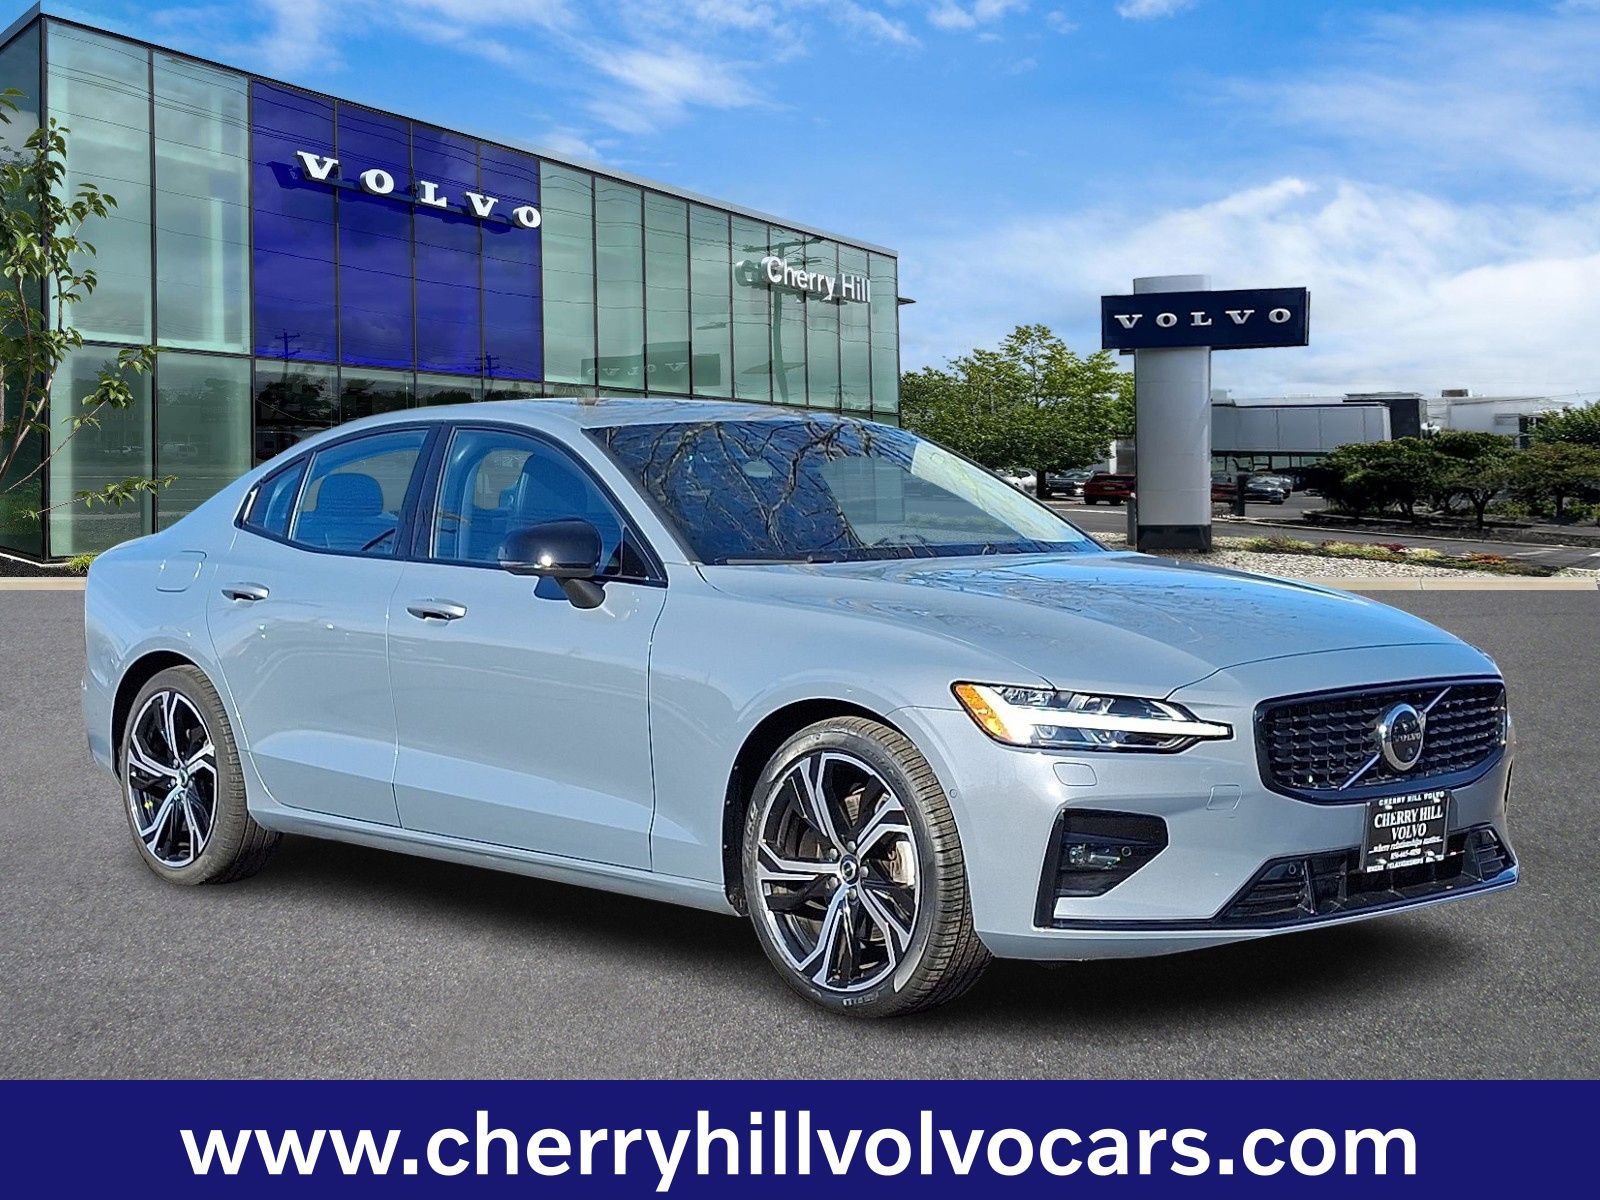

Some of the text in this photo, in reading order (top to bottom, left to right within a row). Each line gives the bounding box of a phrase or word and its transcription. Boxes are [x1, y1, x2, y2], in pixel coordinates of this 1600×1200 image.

[296, 150, 541, 229] VOLVO
[763, 256, 871, 302] Cherry Hill
[1114, 308, 1292, 329] VOLVO
[1378, 790, 1445, 806] CHERRY HILL VOLVO
[1374, 805, 1444, 829] CHERRY HILL
[1391, 822, 1427, 841] VOLVO
